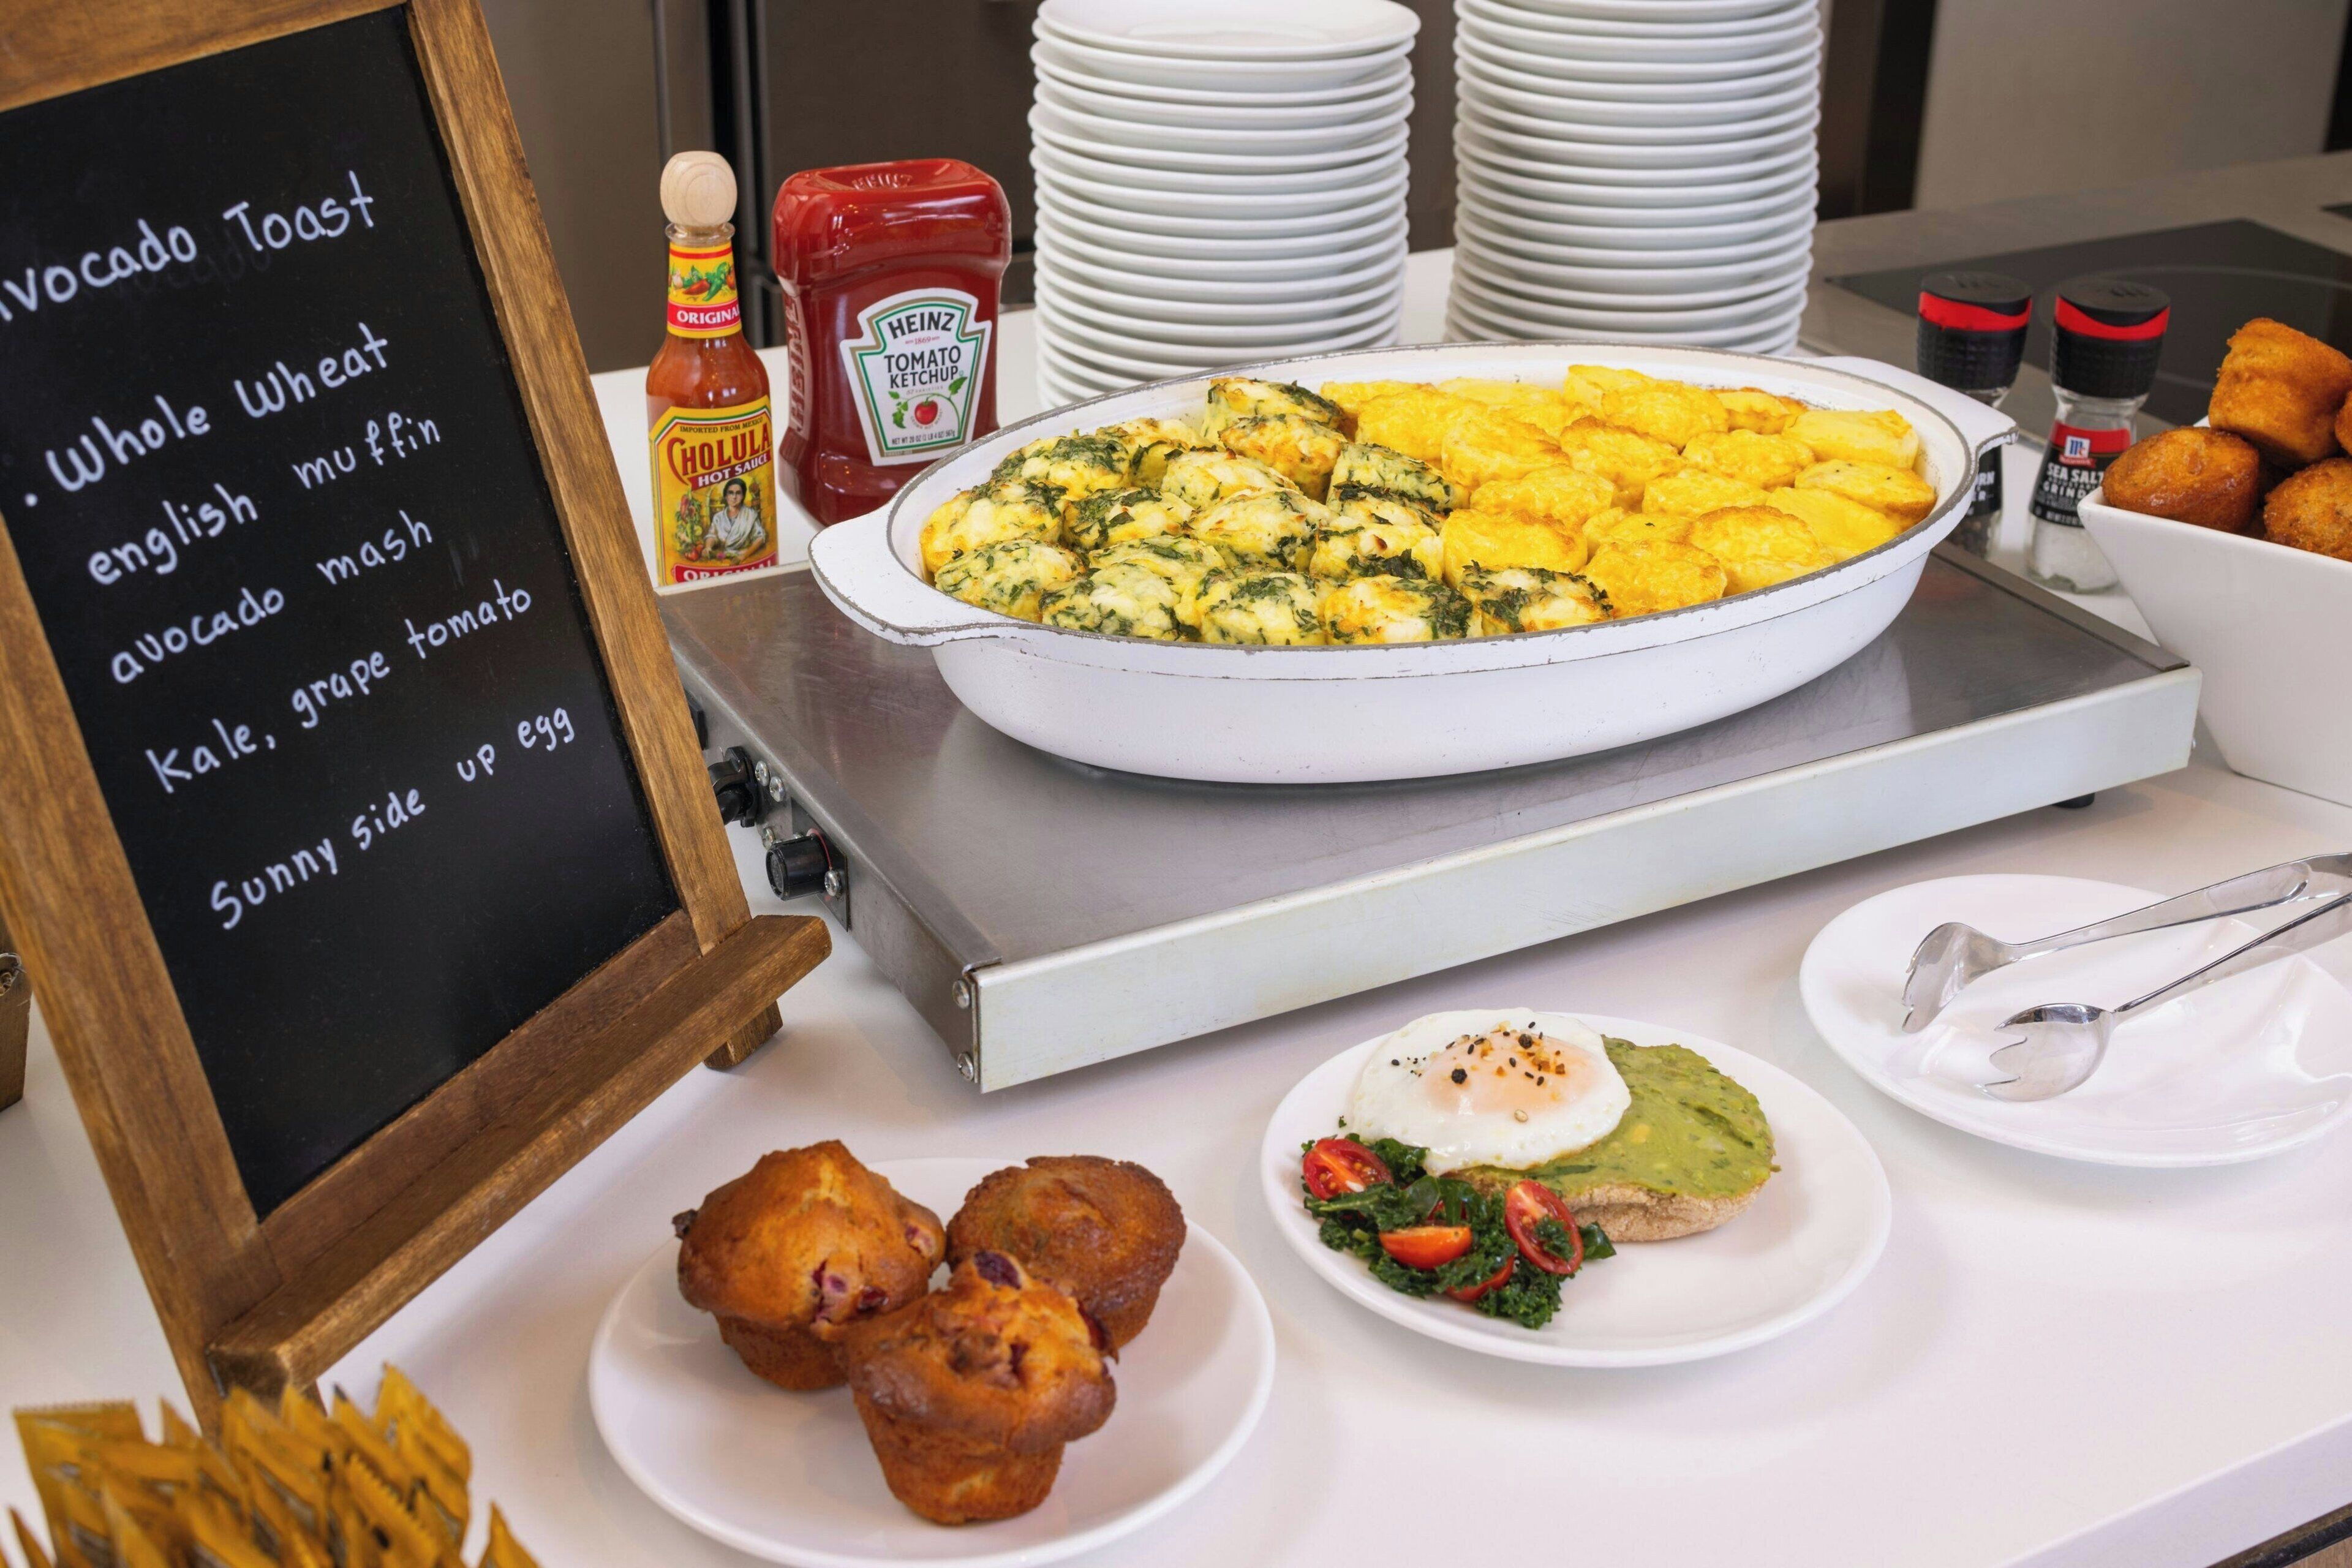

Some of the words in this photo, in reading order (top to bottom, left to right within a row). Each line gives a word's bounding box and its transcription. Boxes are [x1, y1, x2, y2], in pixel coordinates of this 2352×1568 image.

[0, 219, 197, 321] vocado
[223, 170, 374, 252] Toast
[888, 311, 955, 339] HEINZ
[884, 345, 961, 373] TOMATO
[890, 365, 958, 388] KETCHUP
[46, 395, 211, 491] Whole
[234, 322, 388, 418] Wheat
[720, 424, 740, 433] FROM
[742, 417, 763, 428] MEXICO
[667, 422, 771, 486] CHOLULA
[698, 468, 731, 488] HOT
[735, 453, 767, 475] SAUCE
[2047, 462, 2068, 481] SEA
[2070, 469, 2104, 484] SALT
[2043, 481, 2087, 499] GRIND
[88, 483, 258, 585] english
[112, 588, 284, 683] avocado
[317, 510, 432, 584] mash
[292, 652, 390, 728] grape
[405, 579, 531, 659] tomato
[211, 839, 337, 929] Sunny
[352, 789, 425, 850] side
[457, 744, 495, 782] up
[518, 707, 575, 752] egg
